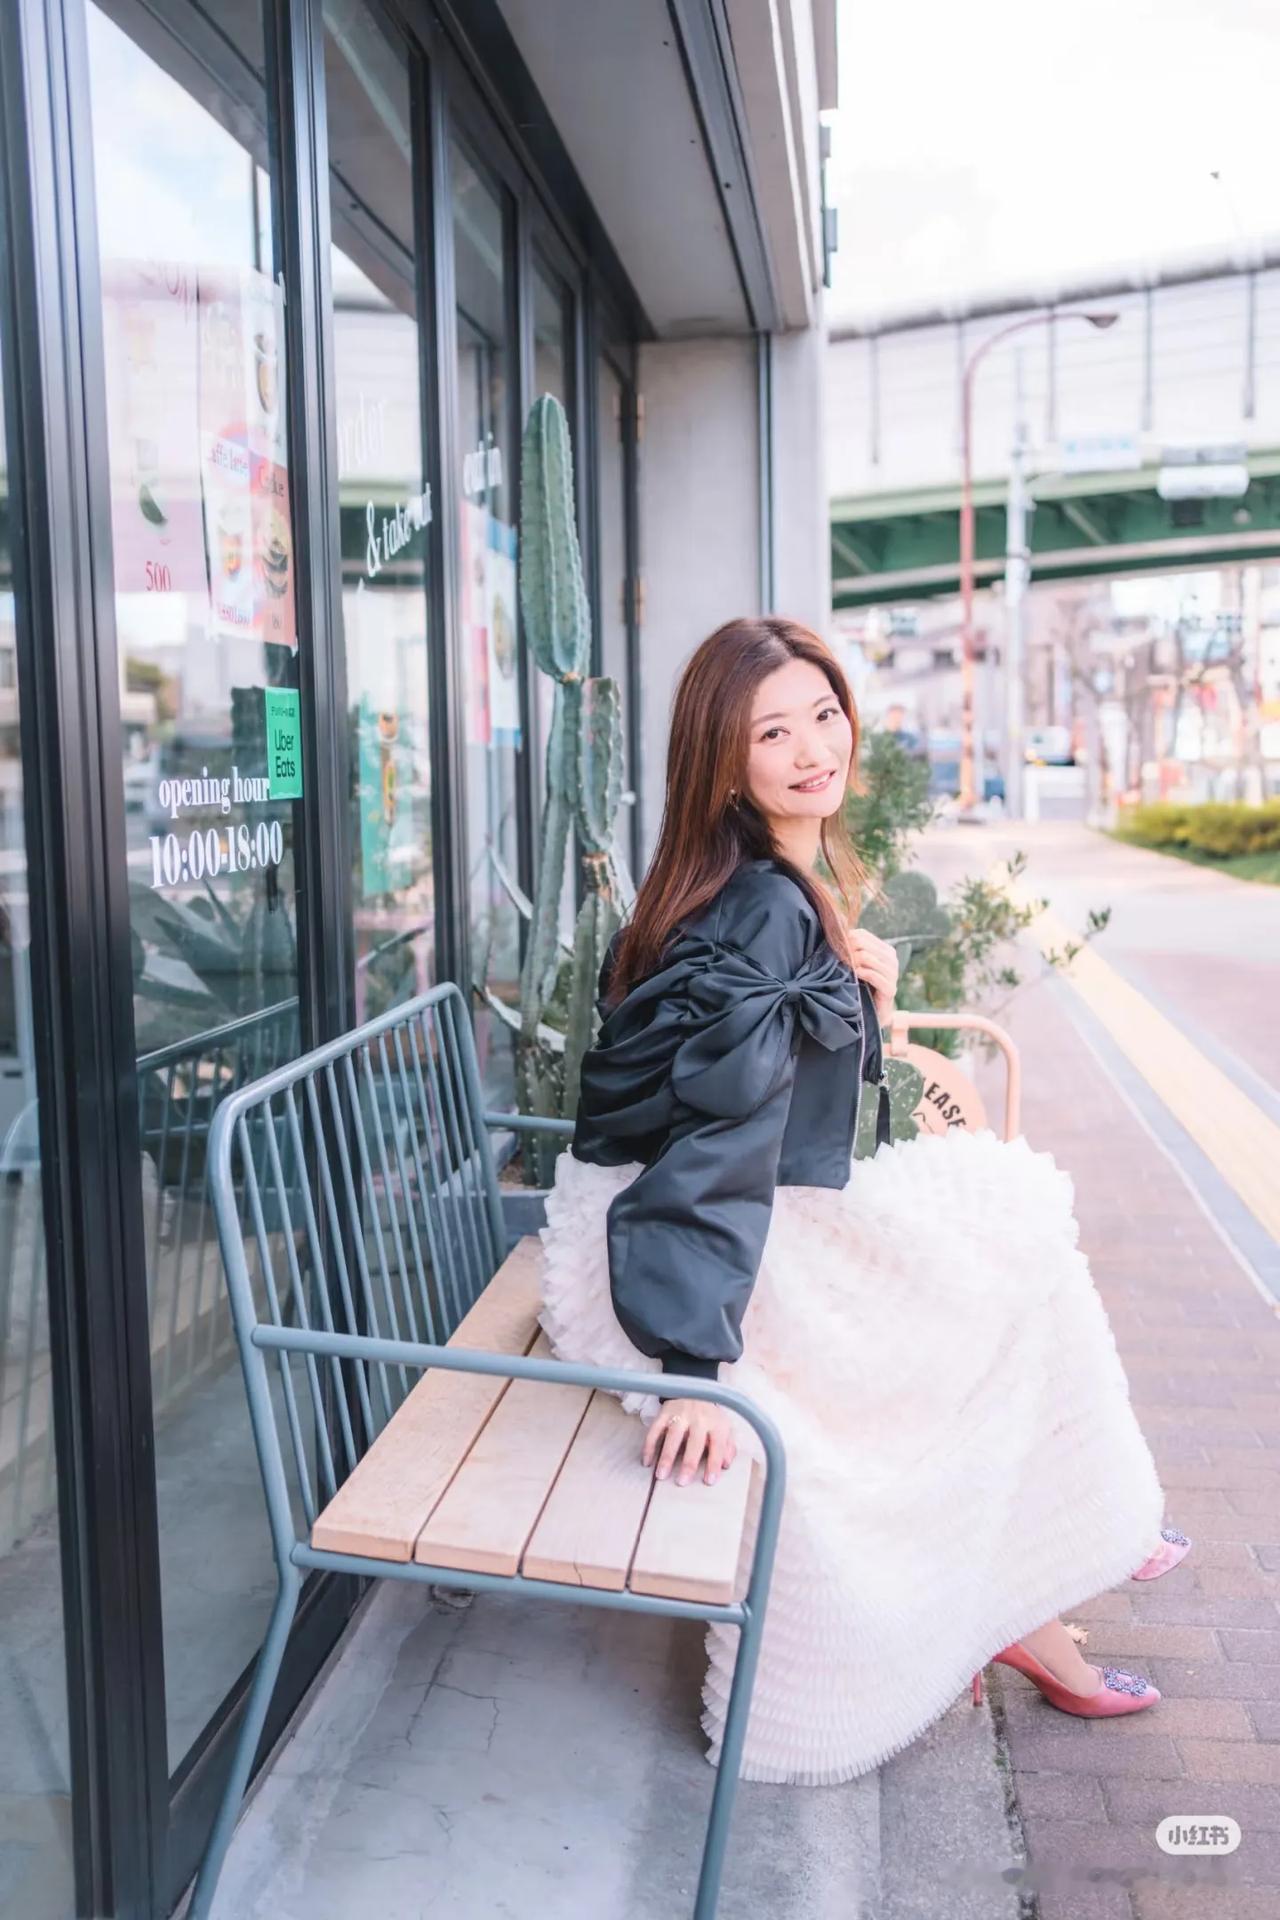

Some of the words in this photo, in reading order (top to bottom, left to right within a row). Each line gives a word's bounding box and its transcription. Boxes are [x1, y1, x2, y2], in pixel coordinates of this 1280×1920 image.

[383, 501, 412, 561] take
[145, 560, 172, 593] 500
[274, 728, 294, 752] Uber
[275, 756, 296, 778] Eats
[159, 766, 231, 819] opening
[149, 820, 284, 889] 10:00-18:00
